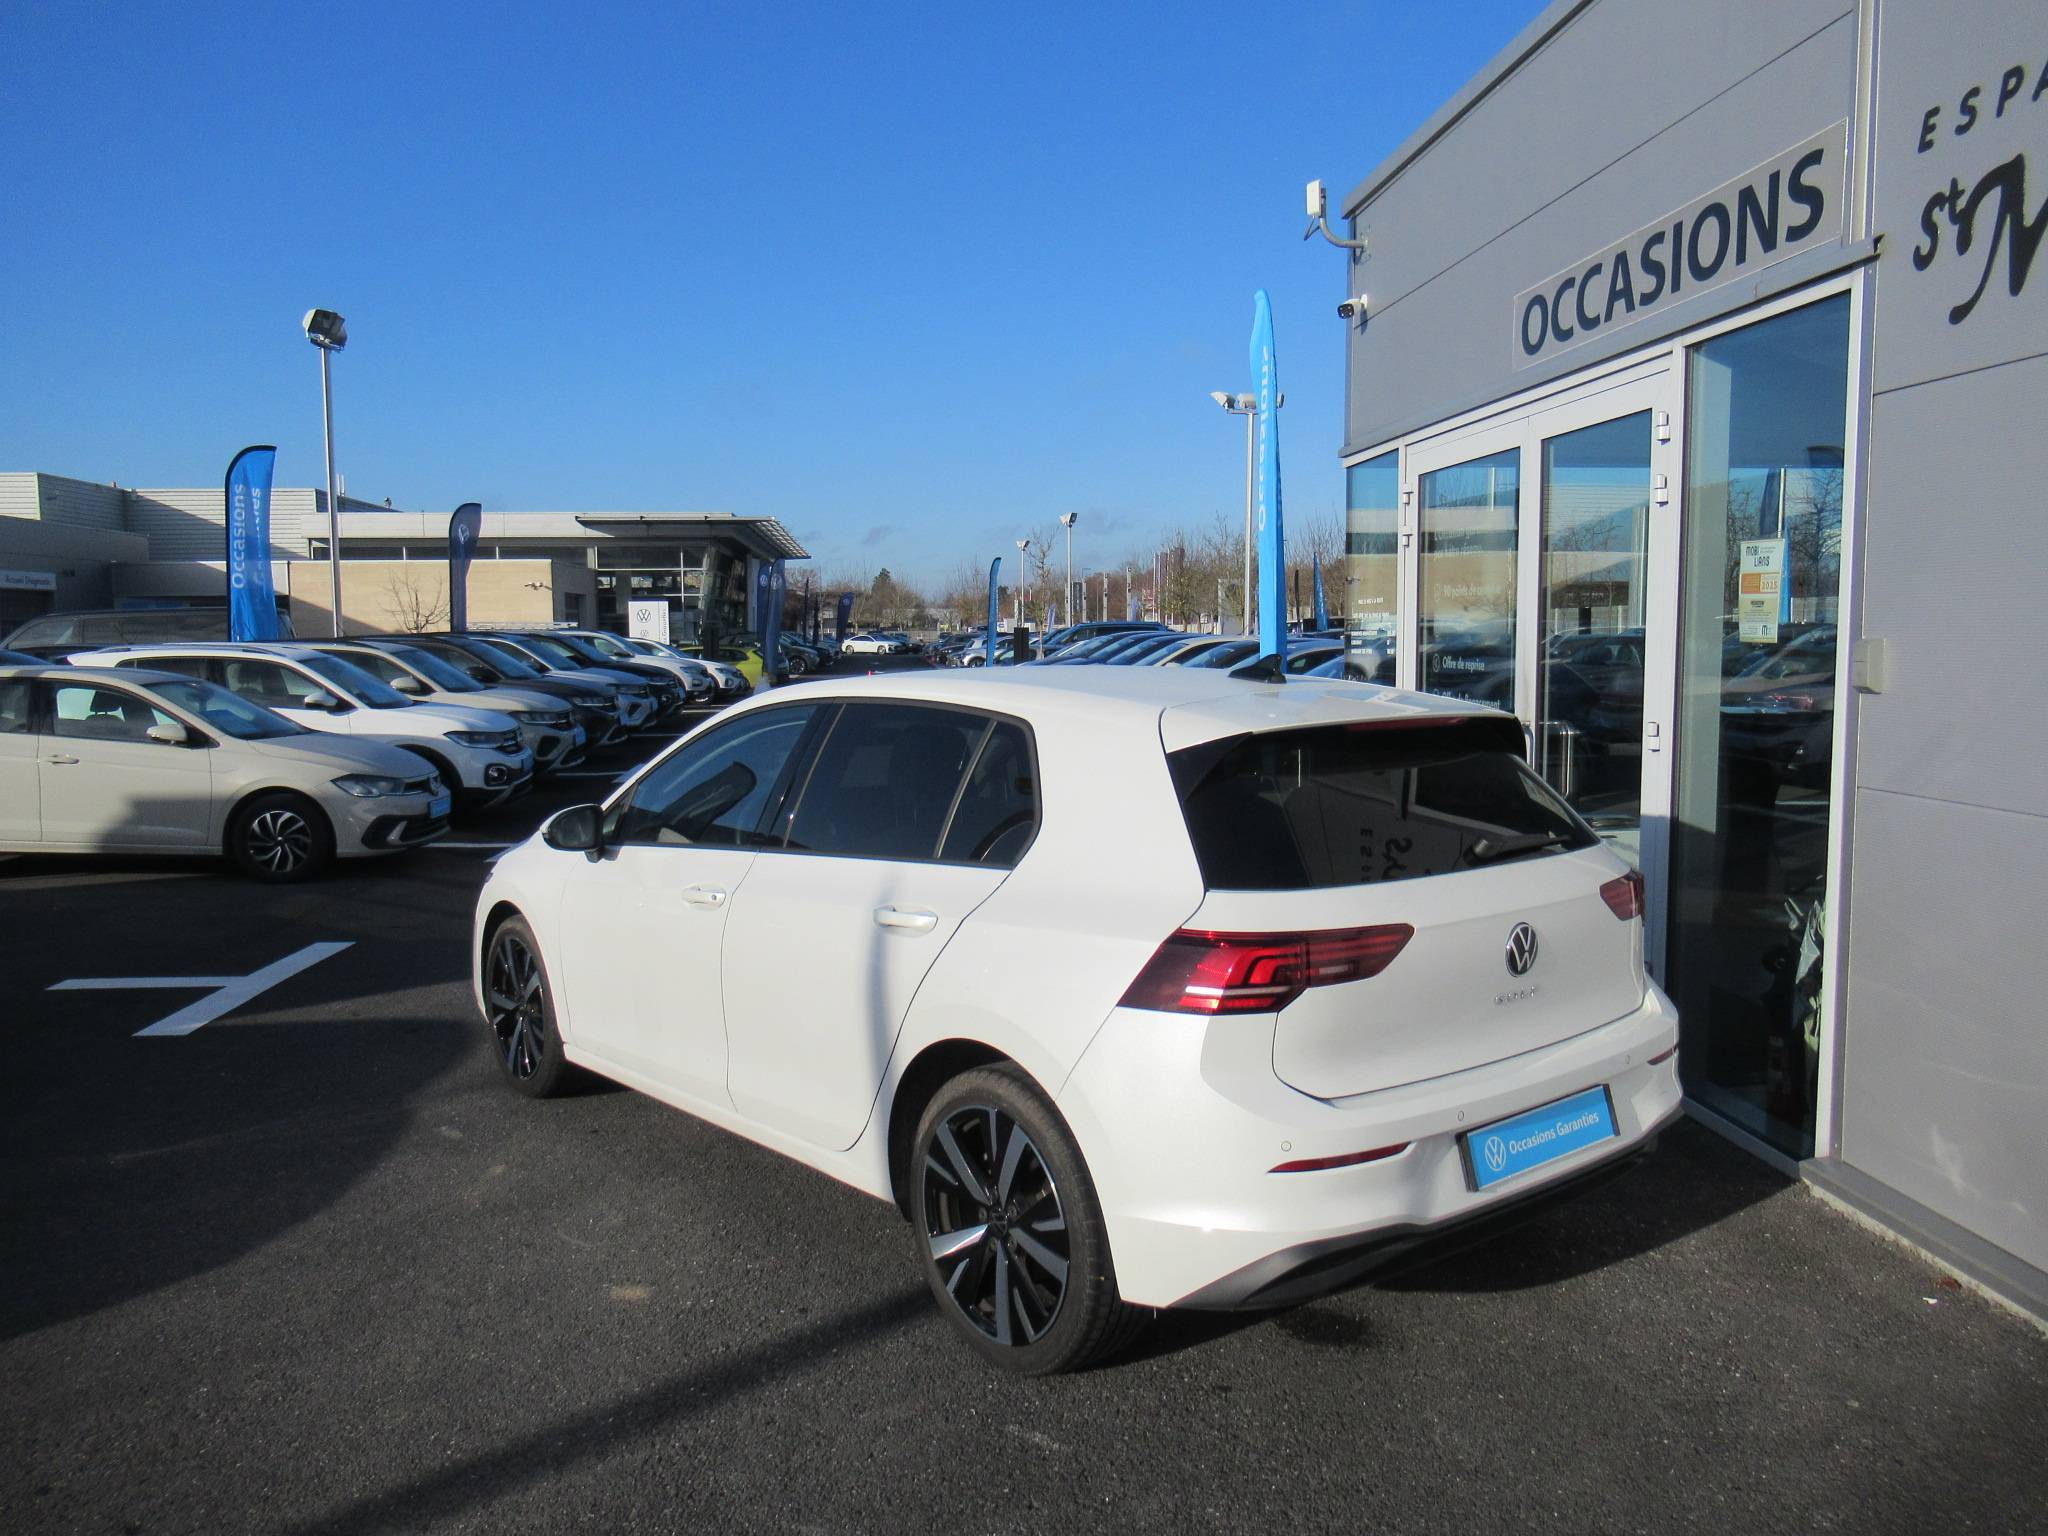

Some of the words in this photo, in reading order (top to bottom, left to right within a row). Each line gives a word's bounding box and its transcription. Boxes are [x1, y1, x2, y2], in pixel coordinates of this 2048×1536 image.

[1521, 148, 1825, 356] OCCASIONS
[231, 483, 246, 589] Occasions
[1442, 655, 1457, 669] Offre
[1465, 658, 1485, 673] reprise
[1509, 1130, 1556, 1154] Occasions
[1557, 1111, 1599, 1136] Garanties
